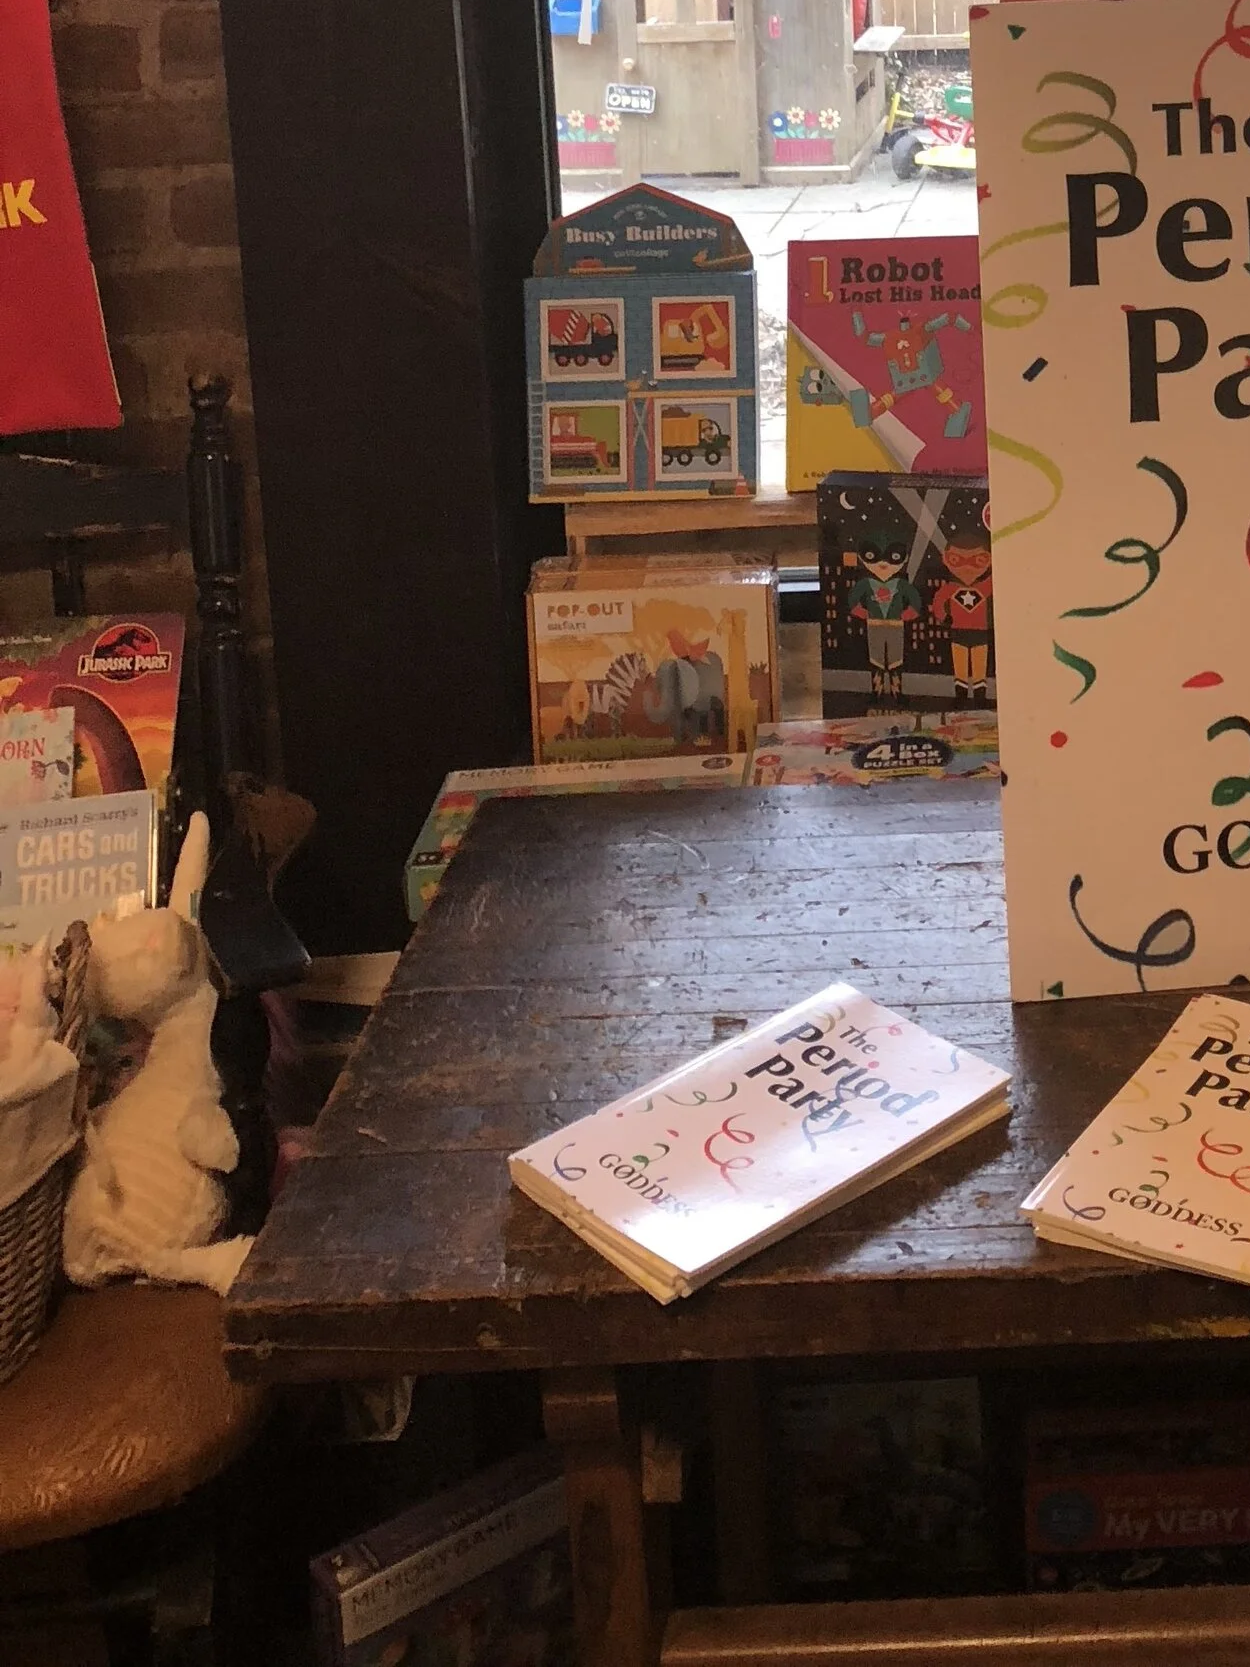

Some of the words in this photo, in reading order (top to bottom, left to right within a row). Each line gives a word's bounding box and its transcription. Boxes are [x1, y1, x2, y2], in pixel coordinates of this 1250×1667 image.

[609, 93, 650, 110] OPEN
[565, 227, 615, 246] Busy
[625, 224, 718, 242] Builders
[841, 256, 944, 283] Robot
[839, 287, 883, 304] Lost
[890, 286, 923, 302] His
[930, 284, 981, 302] Head
[547, 602, 625, 619] POP-OUT
[547, 620, 587, 631] safari
[83, 655, 133, 674] JURASSIC
[134, 654, 168, 670] PARK
[866, 744, 895, 760] 4
[899, 743, 918, 751] in
[556, 762, 613, 774] GAME
[863, 759, 914, 769] PUZZLE
[82, 806, 139, 824] Scarry's
[17, 829, 95, 869] CARS
[101, 827, 139, 855] and
[18, 861, 138, 908] TRUCKS
[840, 1025, 878, 1055] The
[775, 1021, 939, 1118] Period
[744, 1052, 864, 1136] Party
[1108, 1187, 1243, 1236] GODDESS
[1103, 1512, 1151, 1542] My
[1154, 1506, 1240, 1535] VERY
